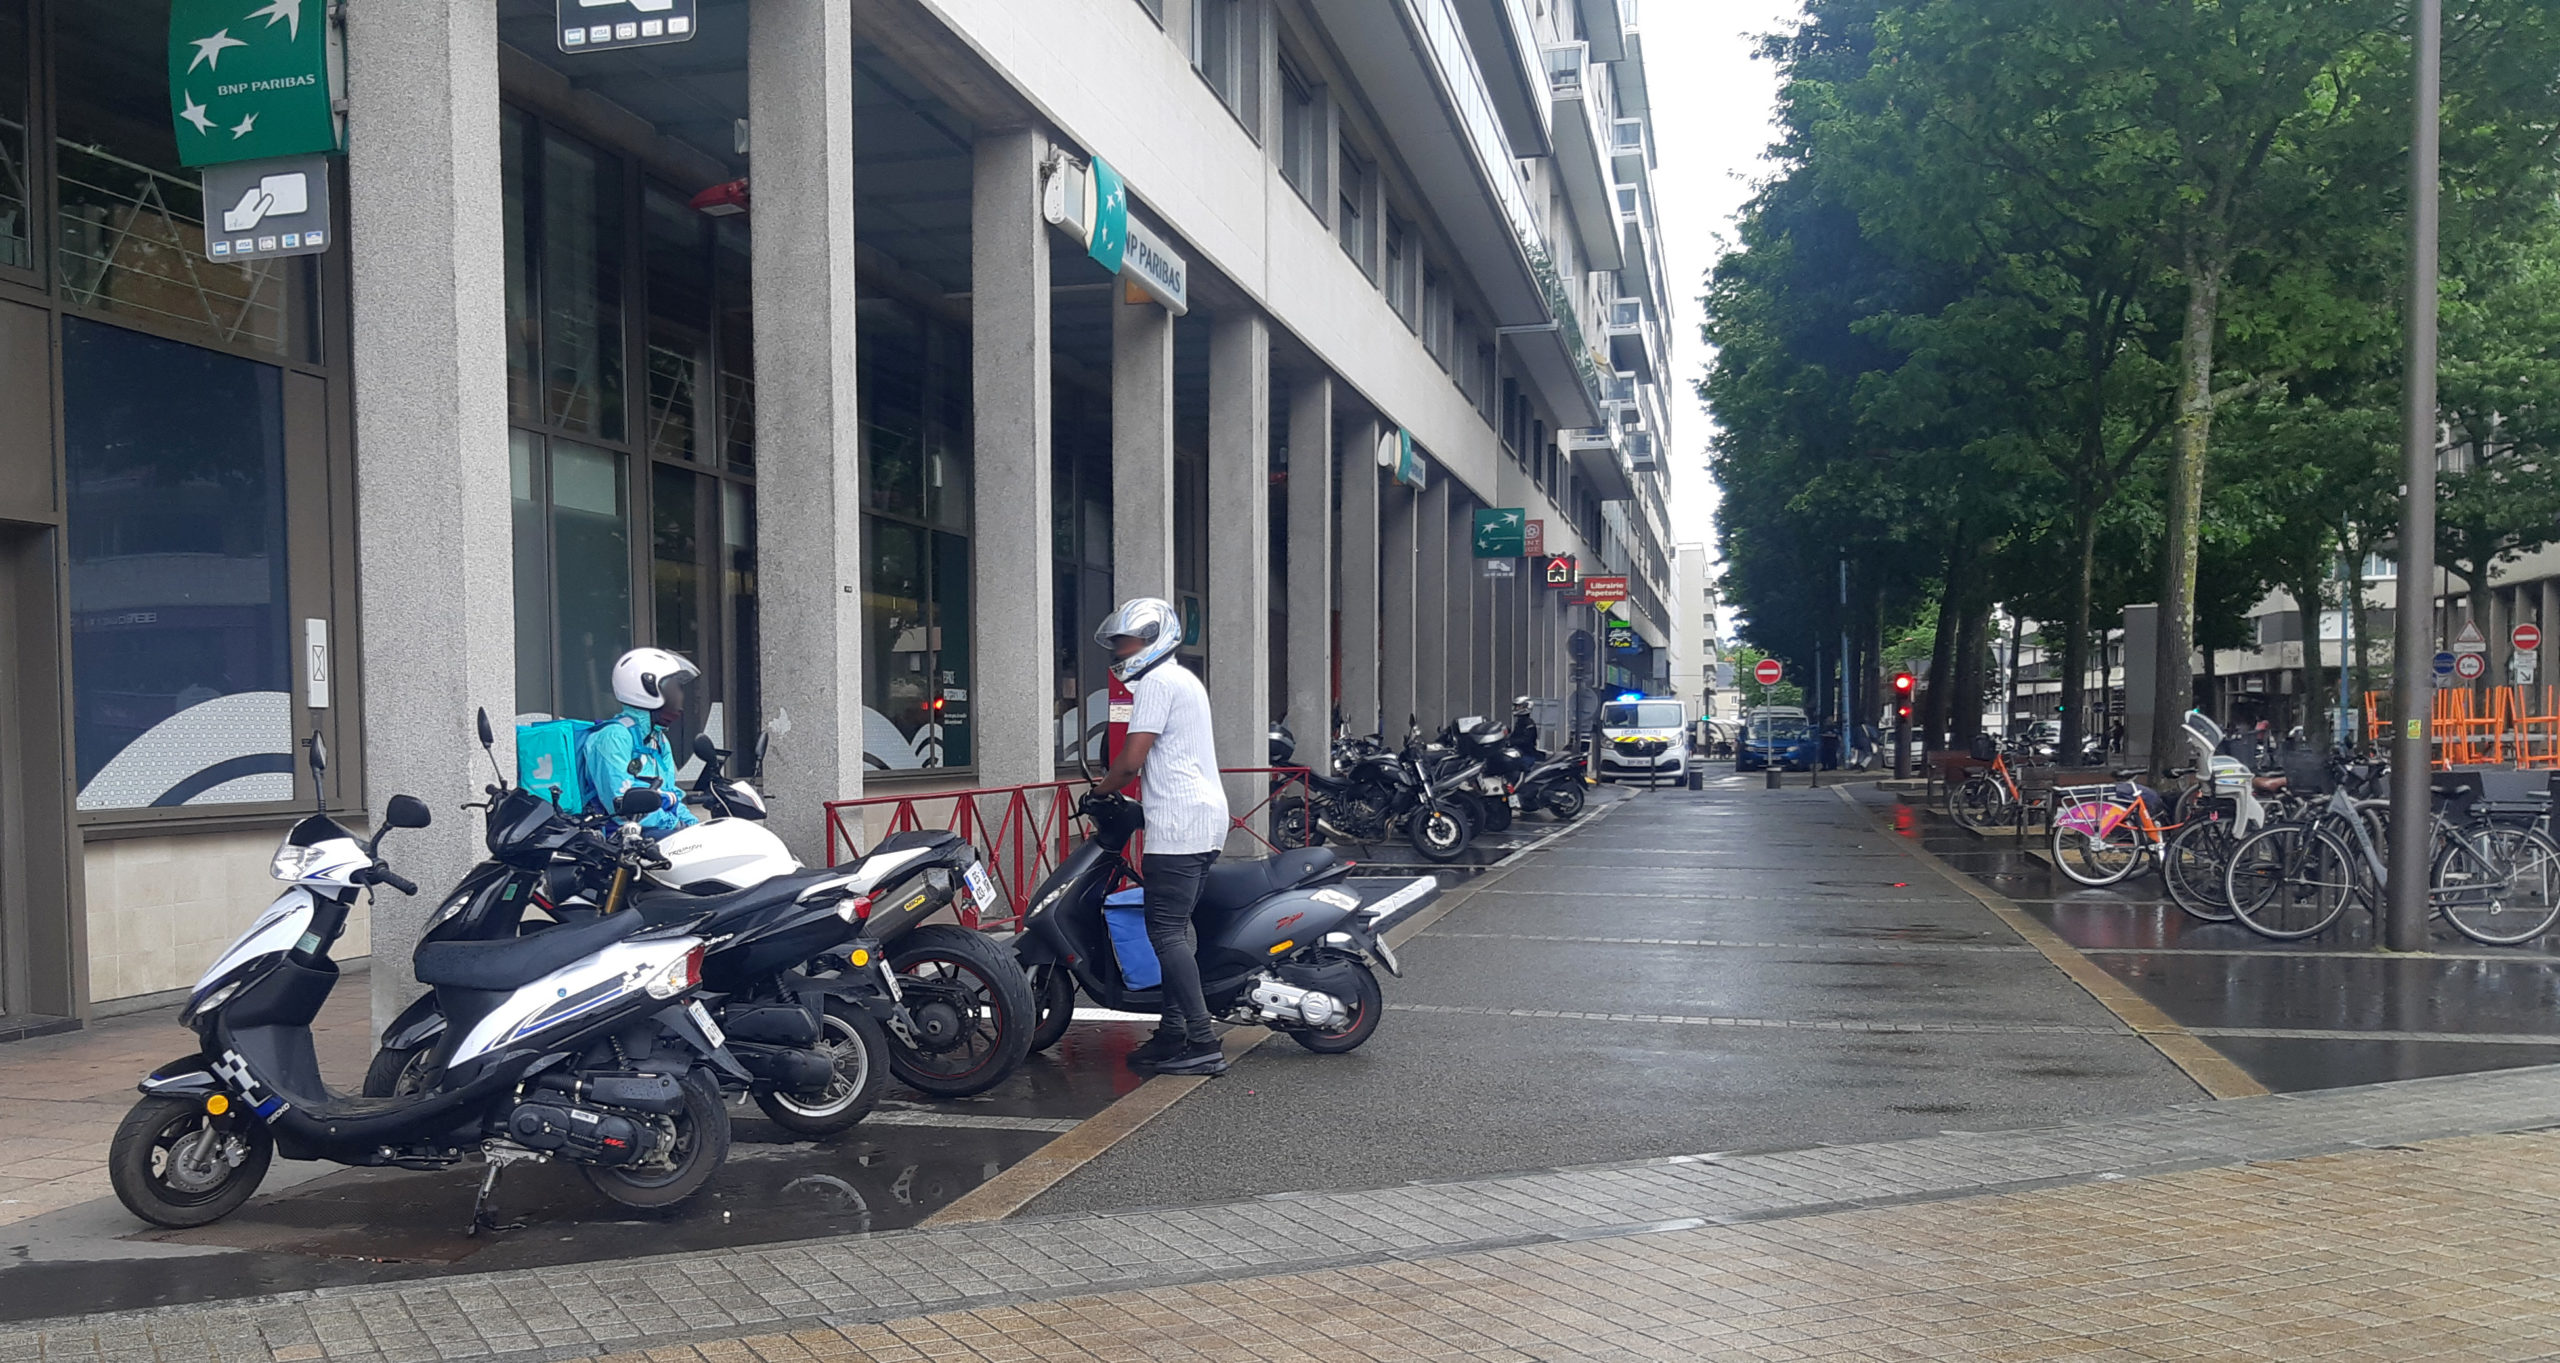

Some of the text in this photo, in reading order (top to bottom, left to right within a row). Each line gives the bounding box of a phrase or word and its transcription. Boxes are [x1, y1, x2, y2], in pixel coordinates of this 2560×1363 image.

[217, 74, 316, 96] BNP PARIBAS
[1126, 231, 1181, 293] NP PARIBAS
